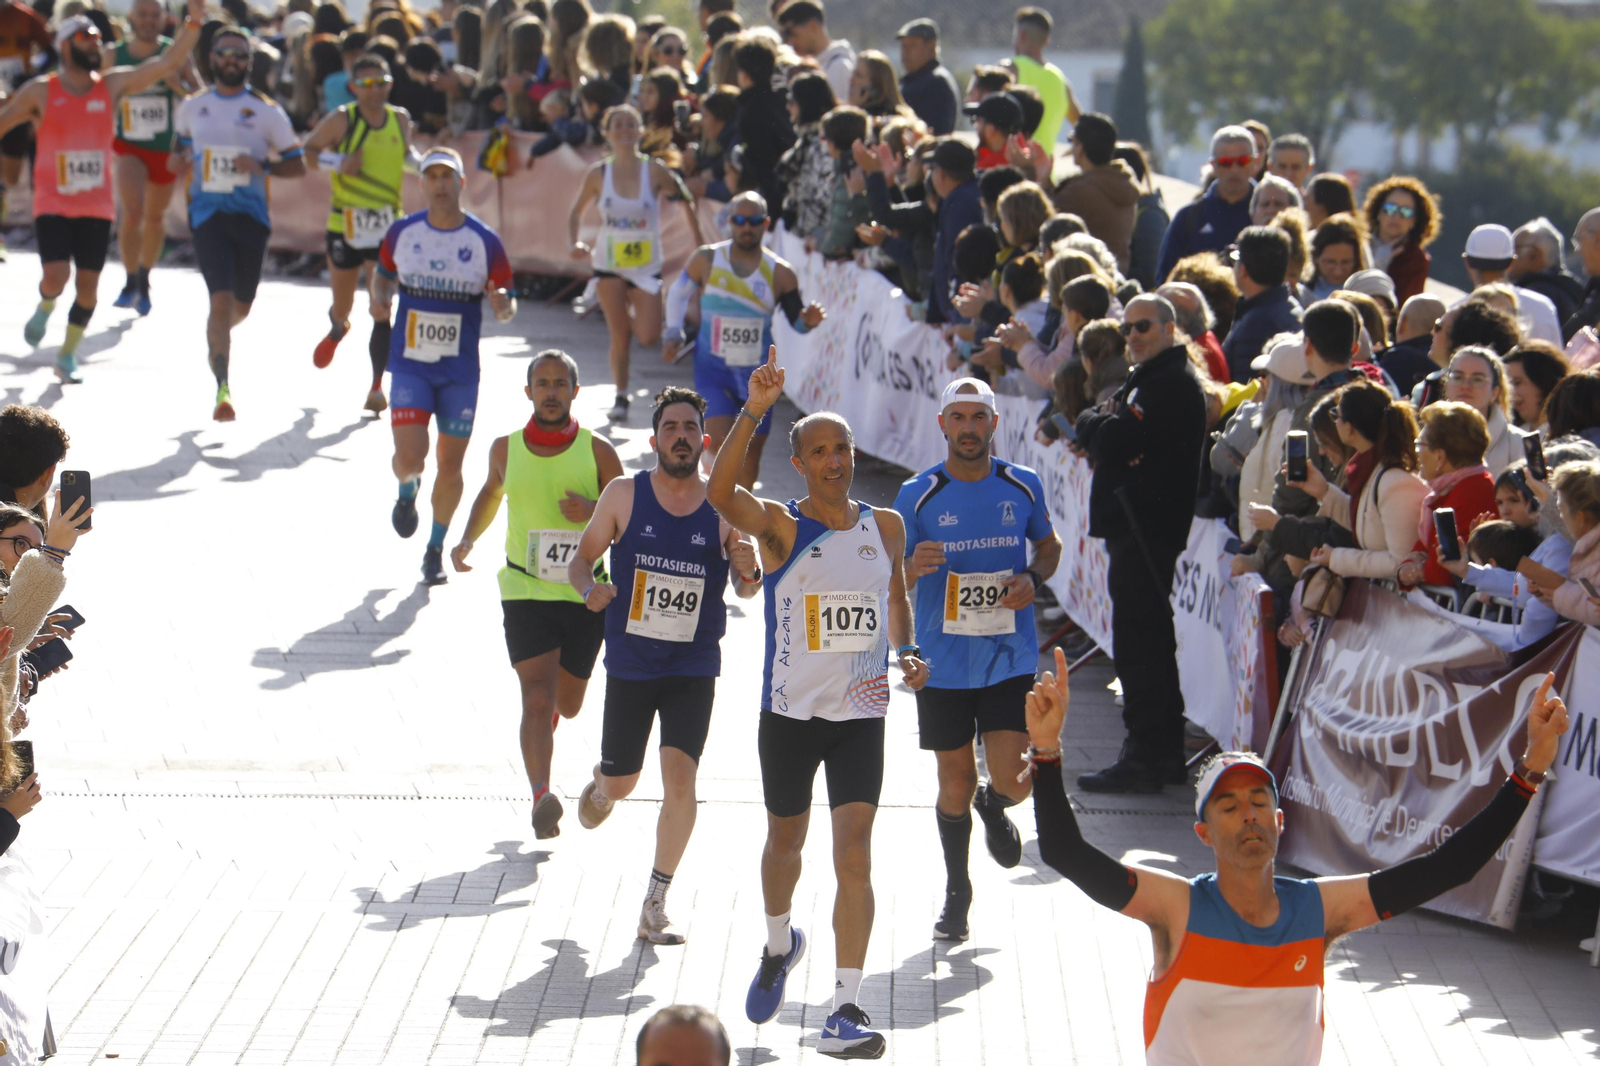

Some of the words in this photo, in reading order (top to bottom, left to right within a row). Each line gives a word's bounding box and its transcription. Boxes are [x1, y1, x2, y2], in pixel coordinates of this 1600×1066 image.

[417, 323, 458, 342] 1009
[722, 327, 759, 343] 5593
[546, 543, 579, 562] 47
[943, 535, 1020, 553] TROTASIERRA
[635, 554, 706, 575] TROTASIERRA
[656, 575, 683, 586] IMDECO
[967, 574, 995, 582] IMDECO
[646, 585, 699, 613] 1949
[821, 606, 877, 631] 1073
[1563, 711, 1600, 777] M
[1394, 804, 1462, 848] Deporte
